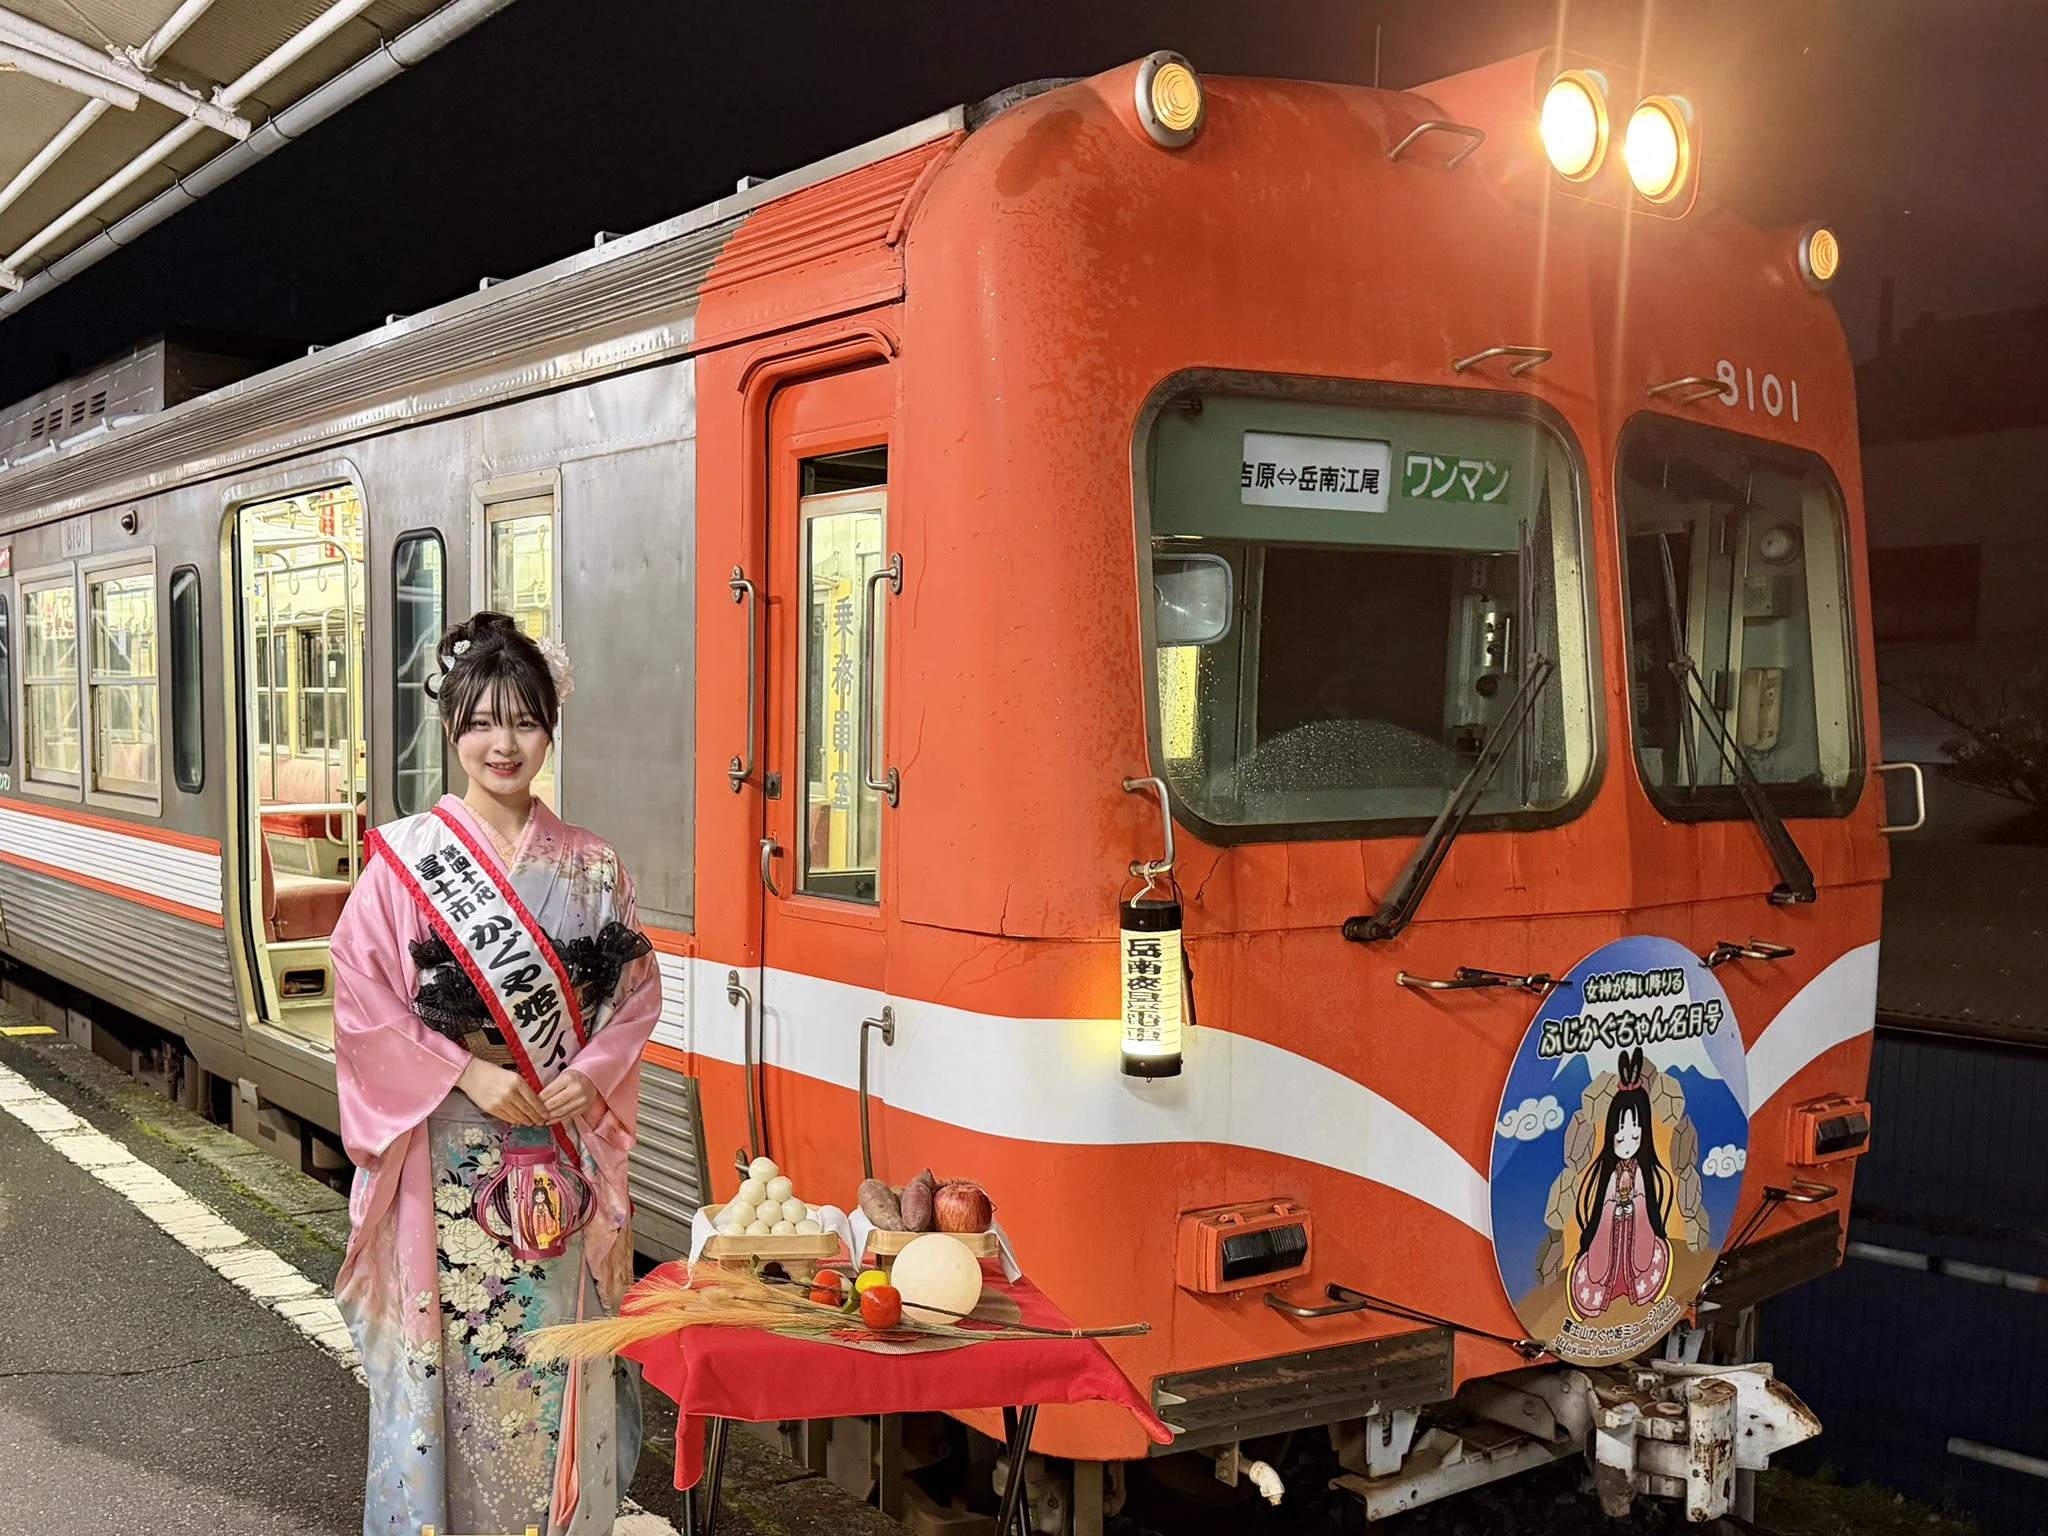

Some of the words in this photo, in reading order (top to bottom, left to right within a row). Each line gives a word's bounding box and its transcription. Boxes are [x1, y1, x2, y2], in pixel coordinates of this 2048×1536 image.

[1716, 360, 1799, 423] 8101
[1298, 465, 1381, 495] 岳南江尾
[1406, 455, 1509, 502] ワンマン
[66, 523, 86, 551] 8101
[830, 595, 855, 811] 乗務員室
[440, 843, 497, 906] 第四十一代
[414, 853, 478, 923] 富士市
[468, 914, 569, 1073] かぐや姫クイ
[1584, 969, 1685, 1002] 女神が舞い降りる
[1539, 1001, 1723, 1055] ふじかぐちゃん名月号
[1562, 1297, 1675, 1341] 富士山かぐや姫ミュージアム
